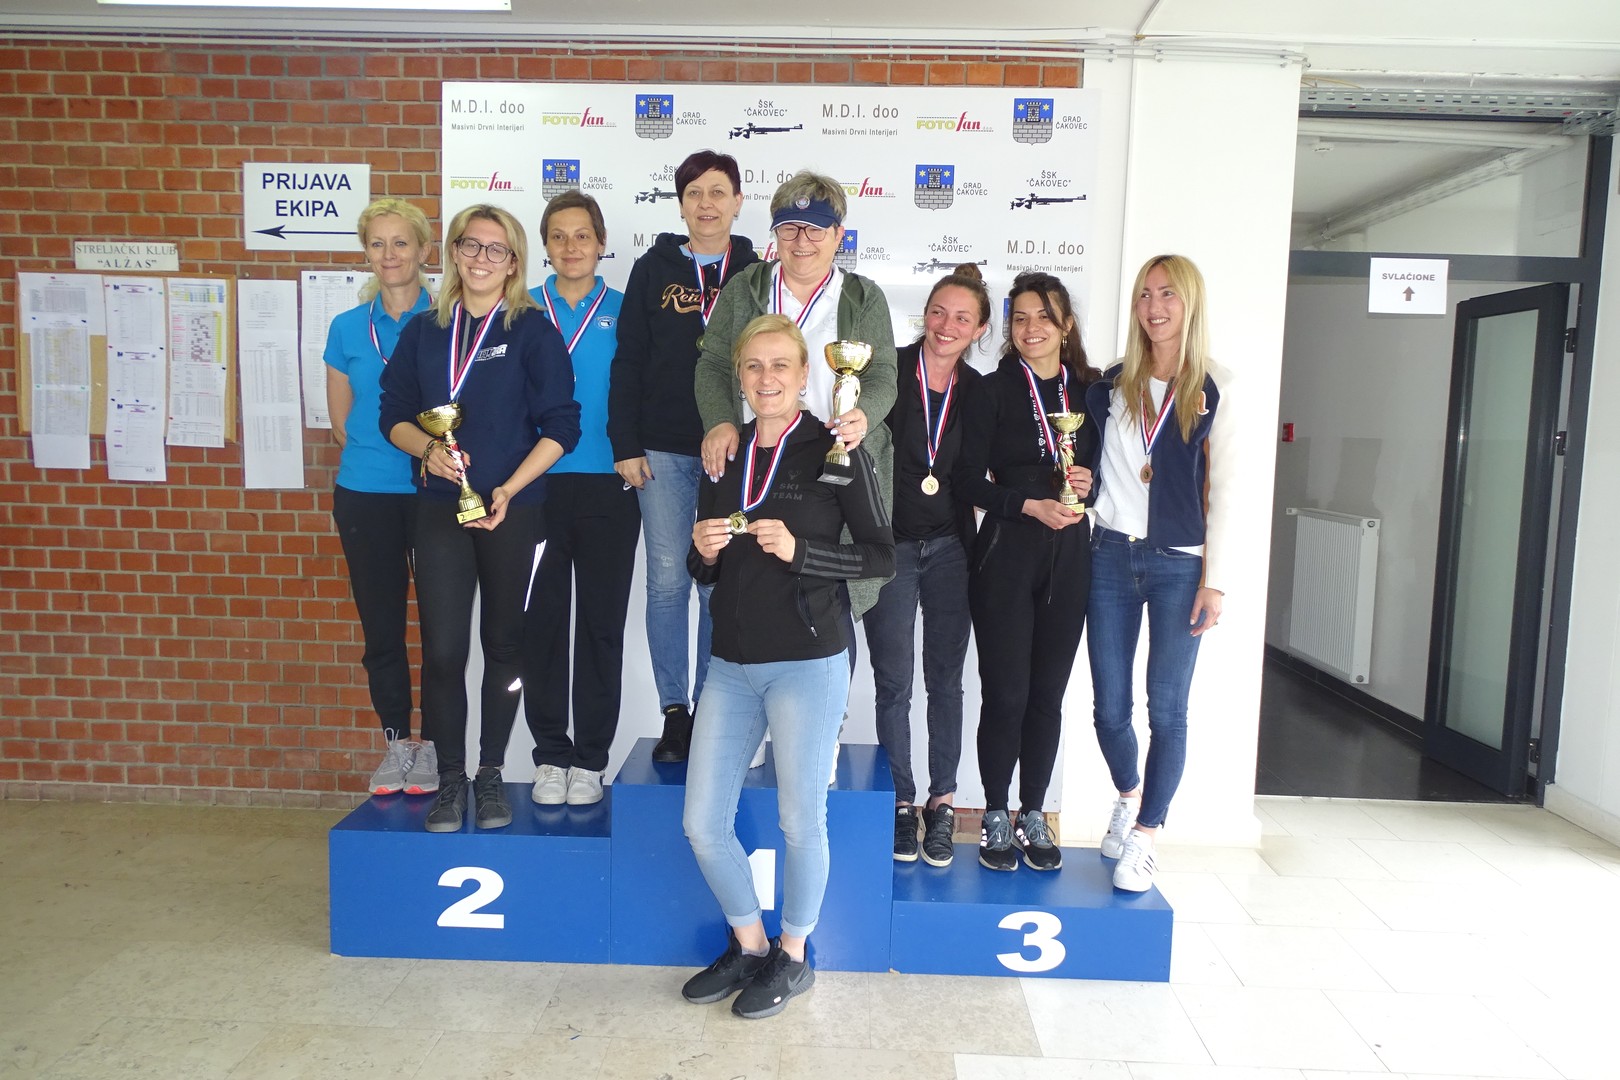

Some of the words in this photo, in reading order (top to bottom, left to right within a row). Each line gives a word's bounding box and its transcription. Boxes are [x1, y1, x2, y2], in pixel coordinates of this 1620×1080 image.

[451, 99, 493, 113] M.D.I.
[500, 100, 525, 114] doo
[758, 99, 774, 109] ŠSK
[822, 104, 866, 119] M.D.I.
[873, 104, 899, 119] doo
[676, 118, 707, 126] ČAKOVEC
[1055, 121, 1088, 130] ČAKOVEC
[451, 123, 476, 131] Masivni
[477, 123, 495, 131] Drvni
[497, 124, 525, 132] Interijeri
[822, 128, 848, 136] Masivni
[849, 128, 867, 136] Drvni
[869, 129, 898, 138] Interijeri
[777, 170, 793, 183] do
[1041, 170, 1057, 179] ŠSK
[262, 173, 352, 191] PRIJAVA
[583, 181, 613, 190] ČAKOVEC
[956, 187, 988, 196] ČAKOVEC
[275, 200, 339, 217] EKIPA
[943, 235, 958, 244] ŠSK
[75, 244, 140, 254] STRELJAČKI
[147, 246, 176, 255] KLUB
[1007, 240, 1050, 254] M.D.I.
[1058, 241, 1085, 255] doo
[859, 253, 891, 261] ČAKOVEC
[1054, 265, 1083, 273] Interijeri
[1382, 272, 1435, 281] SVLAČIONE
[437, 866, 504, 929] 2
[996, 911, 1066, 973] 3
